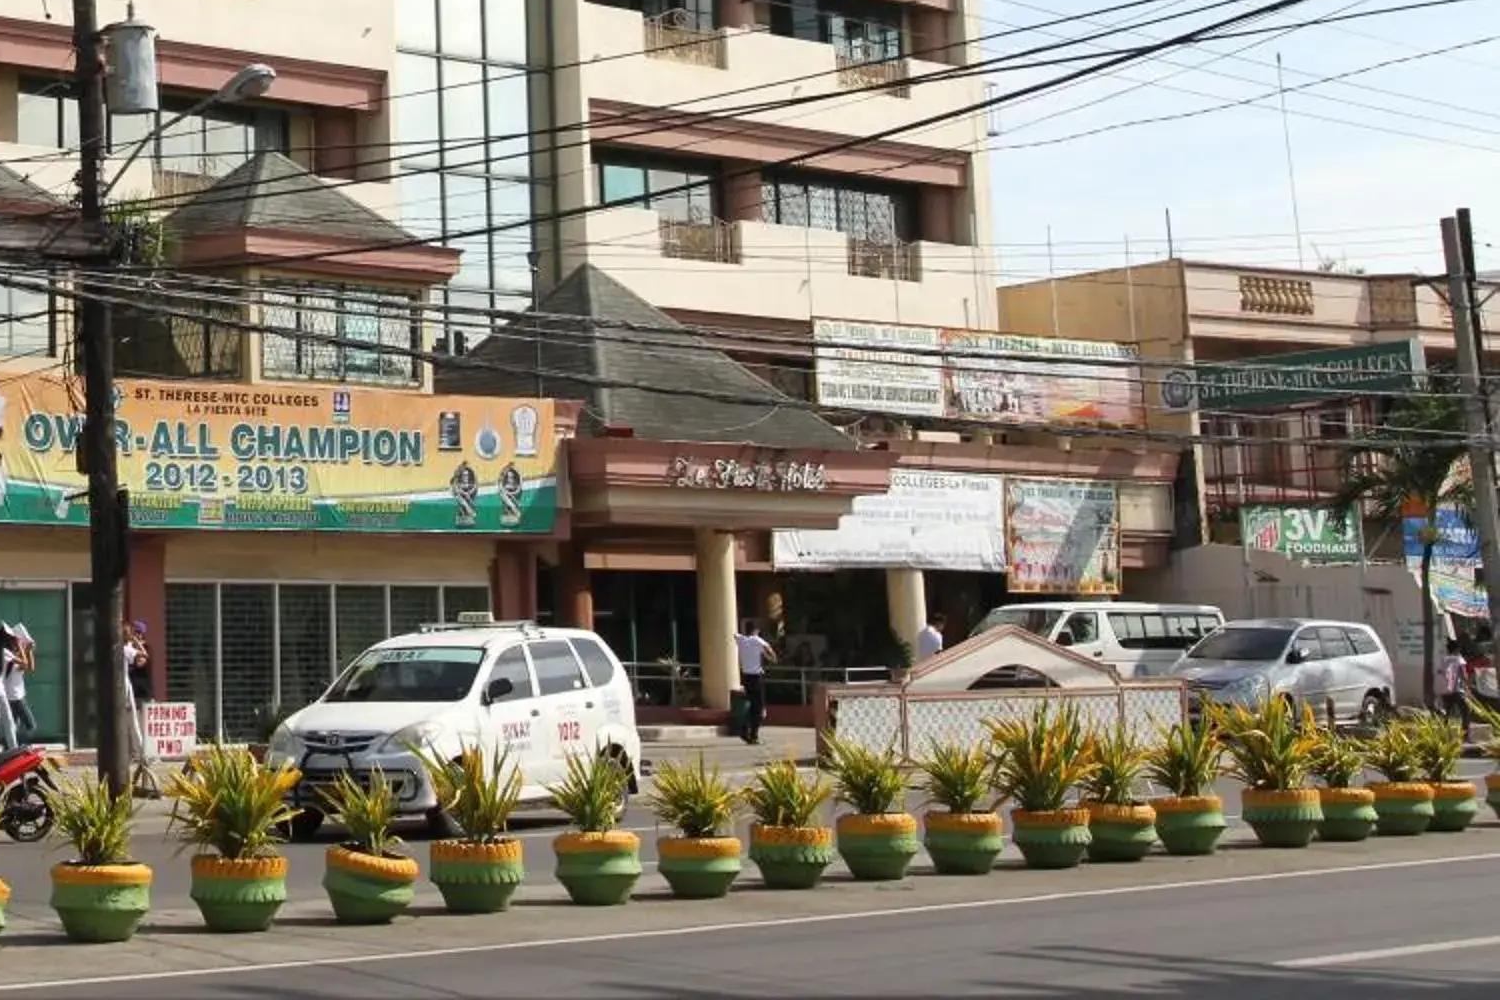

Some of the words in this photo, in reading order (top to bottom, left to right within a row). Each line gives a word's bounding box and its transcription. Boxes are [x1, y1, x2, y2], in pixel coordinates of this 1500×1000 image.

[135, 388, 155, 400] ST.
[253, 394, 319, 407] COLLEGES
[204, 405, 241, 416] FIESTA
[23, 412, 220, 462] OVR-ALL
[230, 422, 423, 467] CHAMPION
